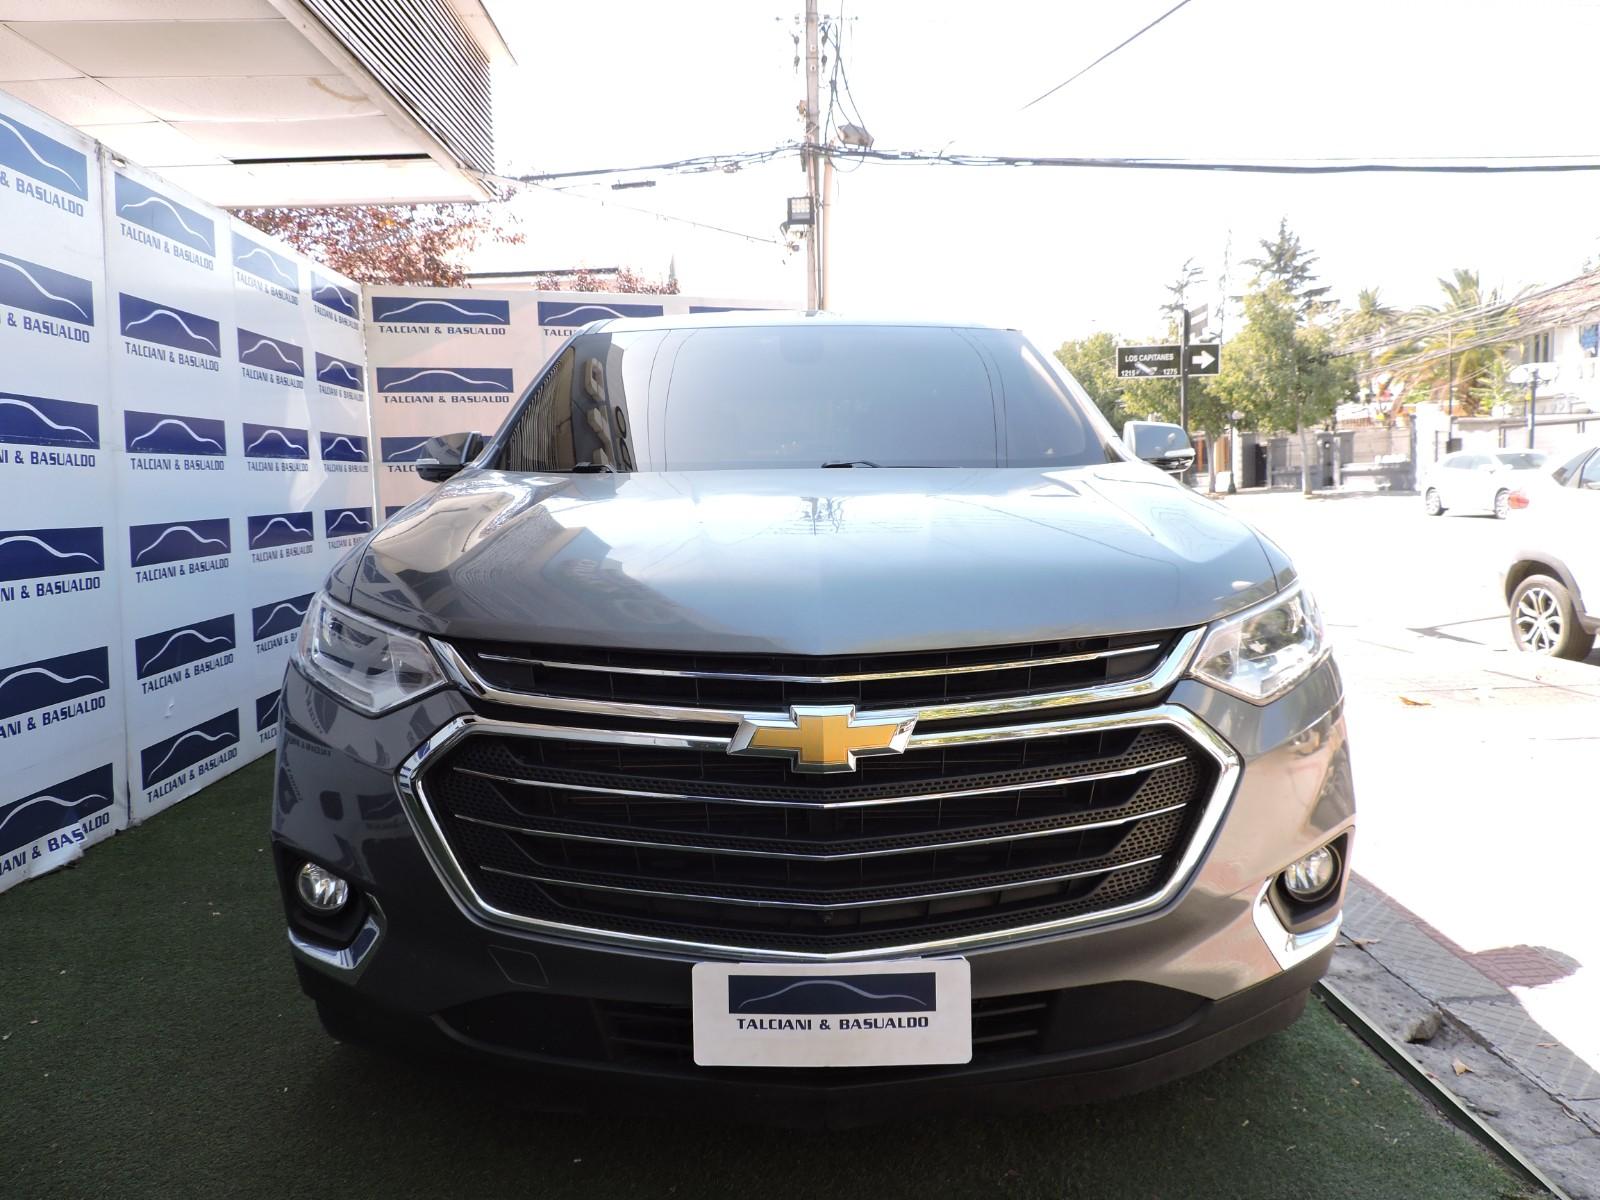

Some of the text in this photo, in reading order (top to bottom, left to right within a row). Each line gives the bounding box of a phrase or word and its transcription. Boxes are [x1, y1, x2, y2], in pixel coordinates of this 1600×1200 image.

[0, 171, 84, 217] & BASUALDO
[120, 223, 214, 271] TALCIANI & BASUALDO
[7, 312, 17, 327] &
[23, 316, 90, 343] BASUALDO
[379, 325, 506, 335] TALCIANI & BASUALDO
[125, 342, 219, 372] TALCIANI & BASUALDO
[1124, 353, 1174, 362] LOS CAPITANES
[383, 395, 510, 403] TALCIANI & BASUALDO
[15, 450, 24, 464] &
[30, 451, 96, 467] BASUALDO
[130, 458, 224, 471] TALCIANI & BASUALDO
[136, 558, 229, 583] TALCIANI & BASUALDO
[20, 585, 30, 599] &
[36, 576, 100, 597] BASUALDO
[142, 653, 234, 694] TALCIANI & BASUALDO
[27, 717, 36, 731] &
[42, 696, 106, 726] BASUALDO
[147, 747, 237, 803] TALCIANI & BASUALDO
[32, 845, 41, 859] &
[47, 812, 110, 852] BASALDO
[736, 1016, 929, 1031] TALCIANI & BASUALDO
